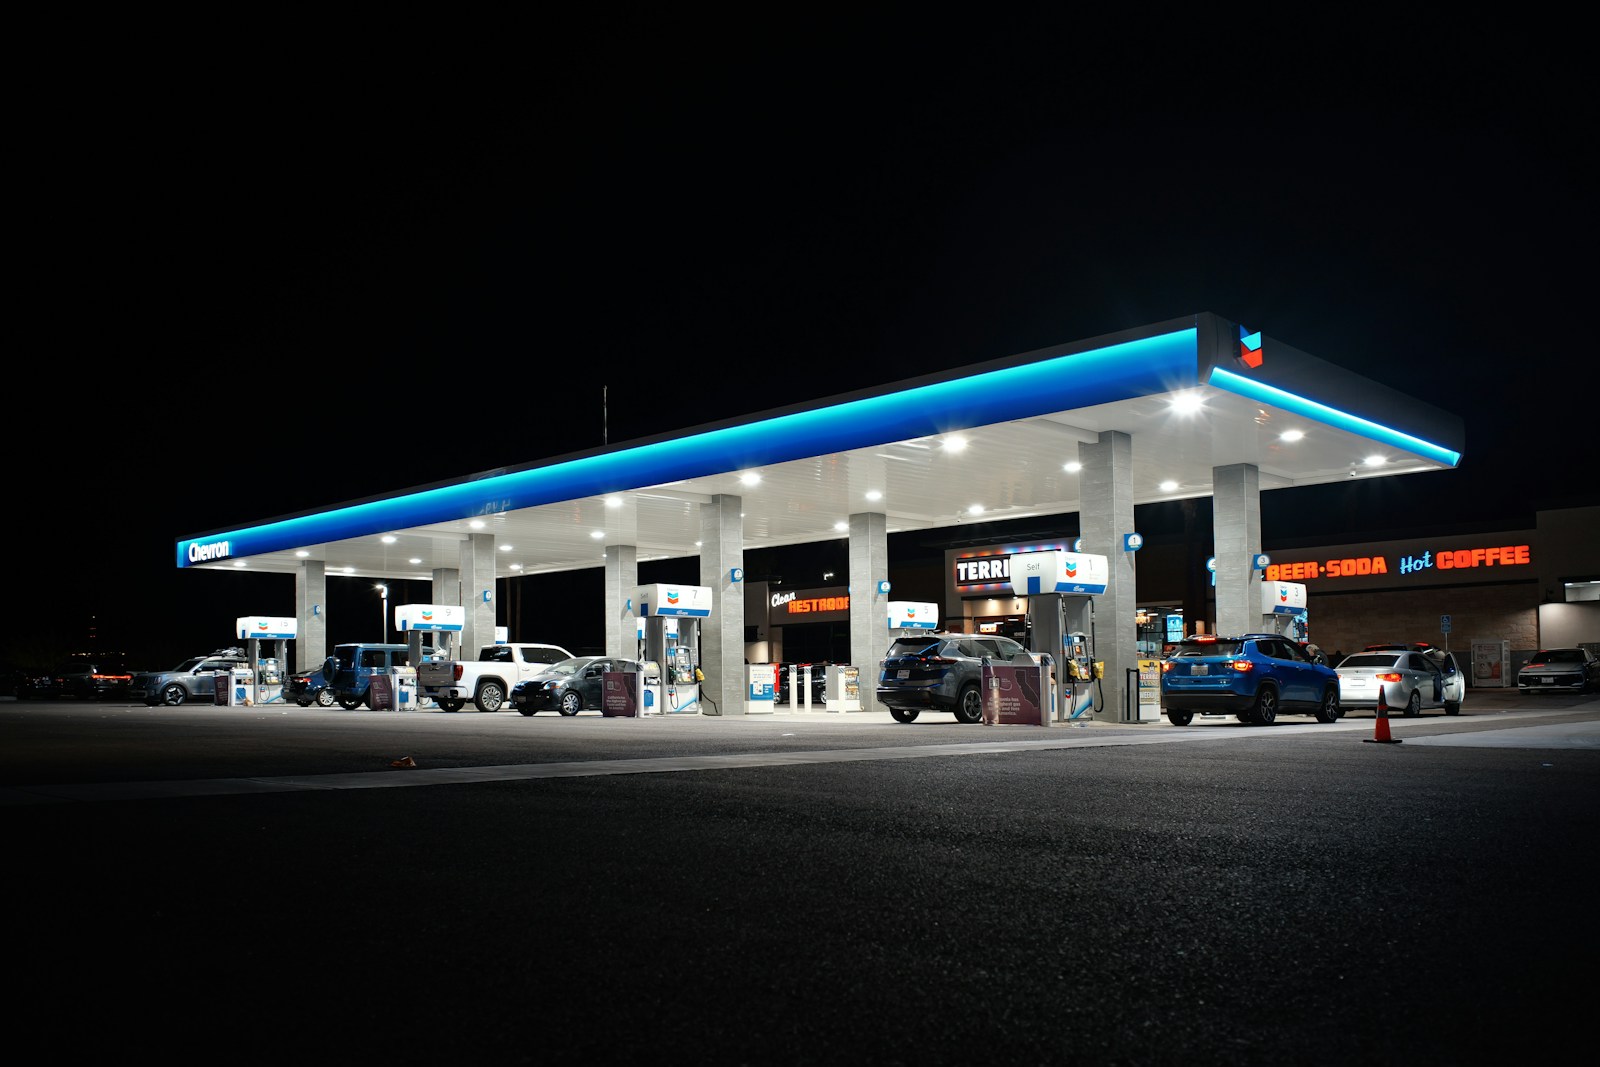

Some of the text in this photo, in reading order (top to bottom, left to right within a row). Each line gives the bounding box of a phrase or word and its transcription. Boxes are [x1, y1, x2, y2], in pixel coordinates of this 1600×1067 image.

[189, 541, 229, 562] Chevron
[1026, 563, 1040, 571] Self
[1400, 545, 1530, 574] Hot COFFEE
[692, 589, 698, 599] 7
[771, 592, 797, 607] Clean
